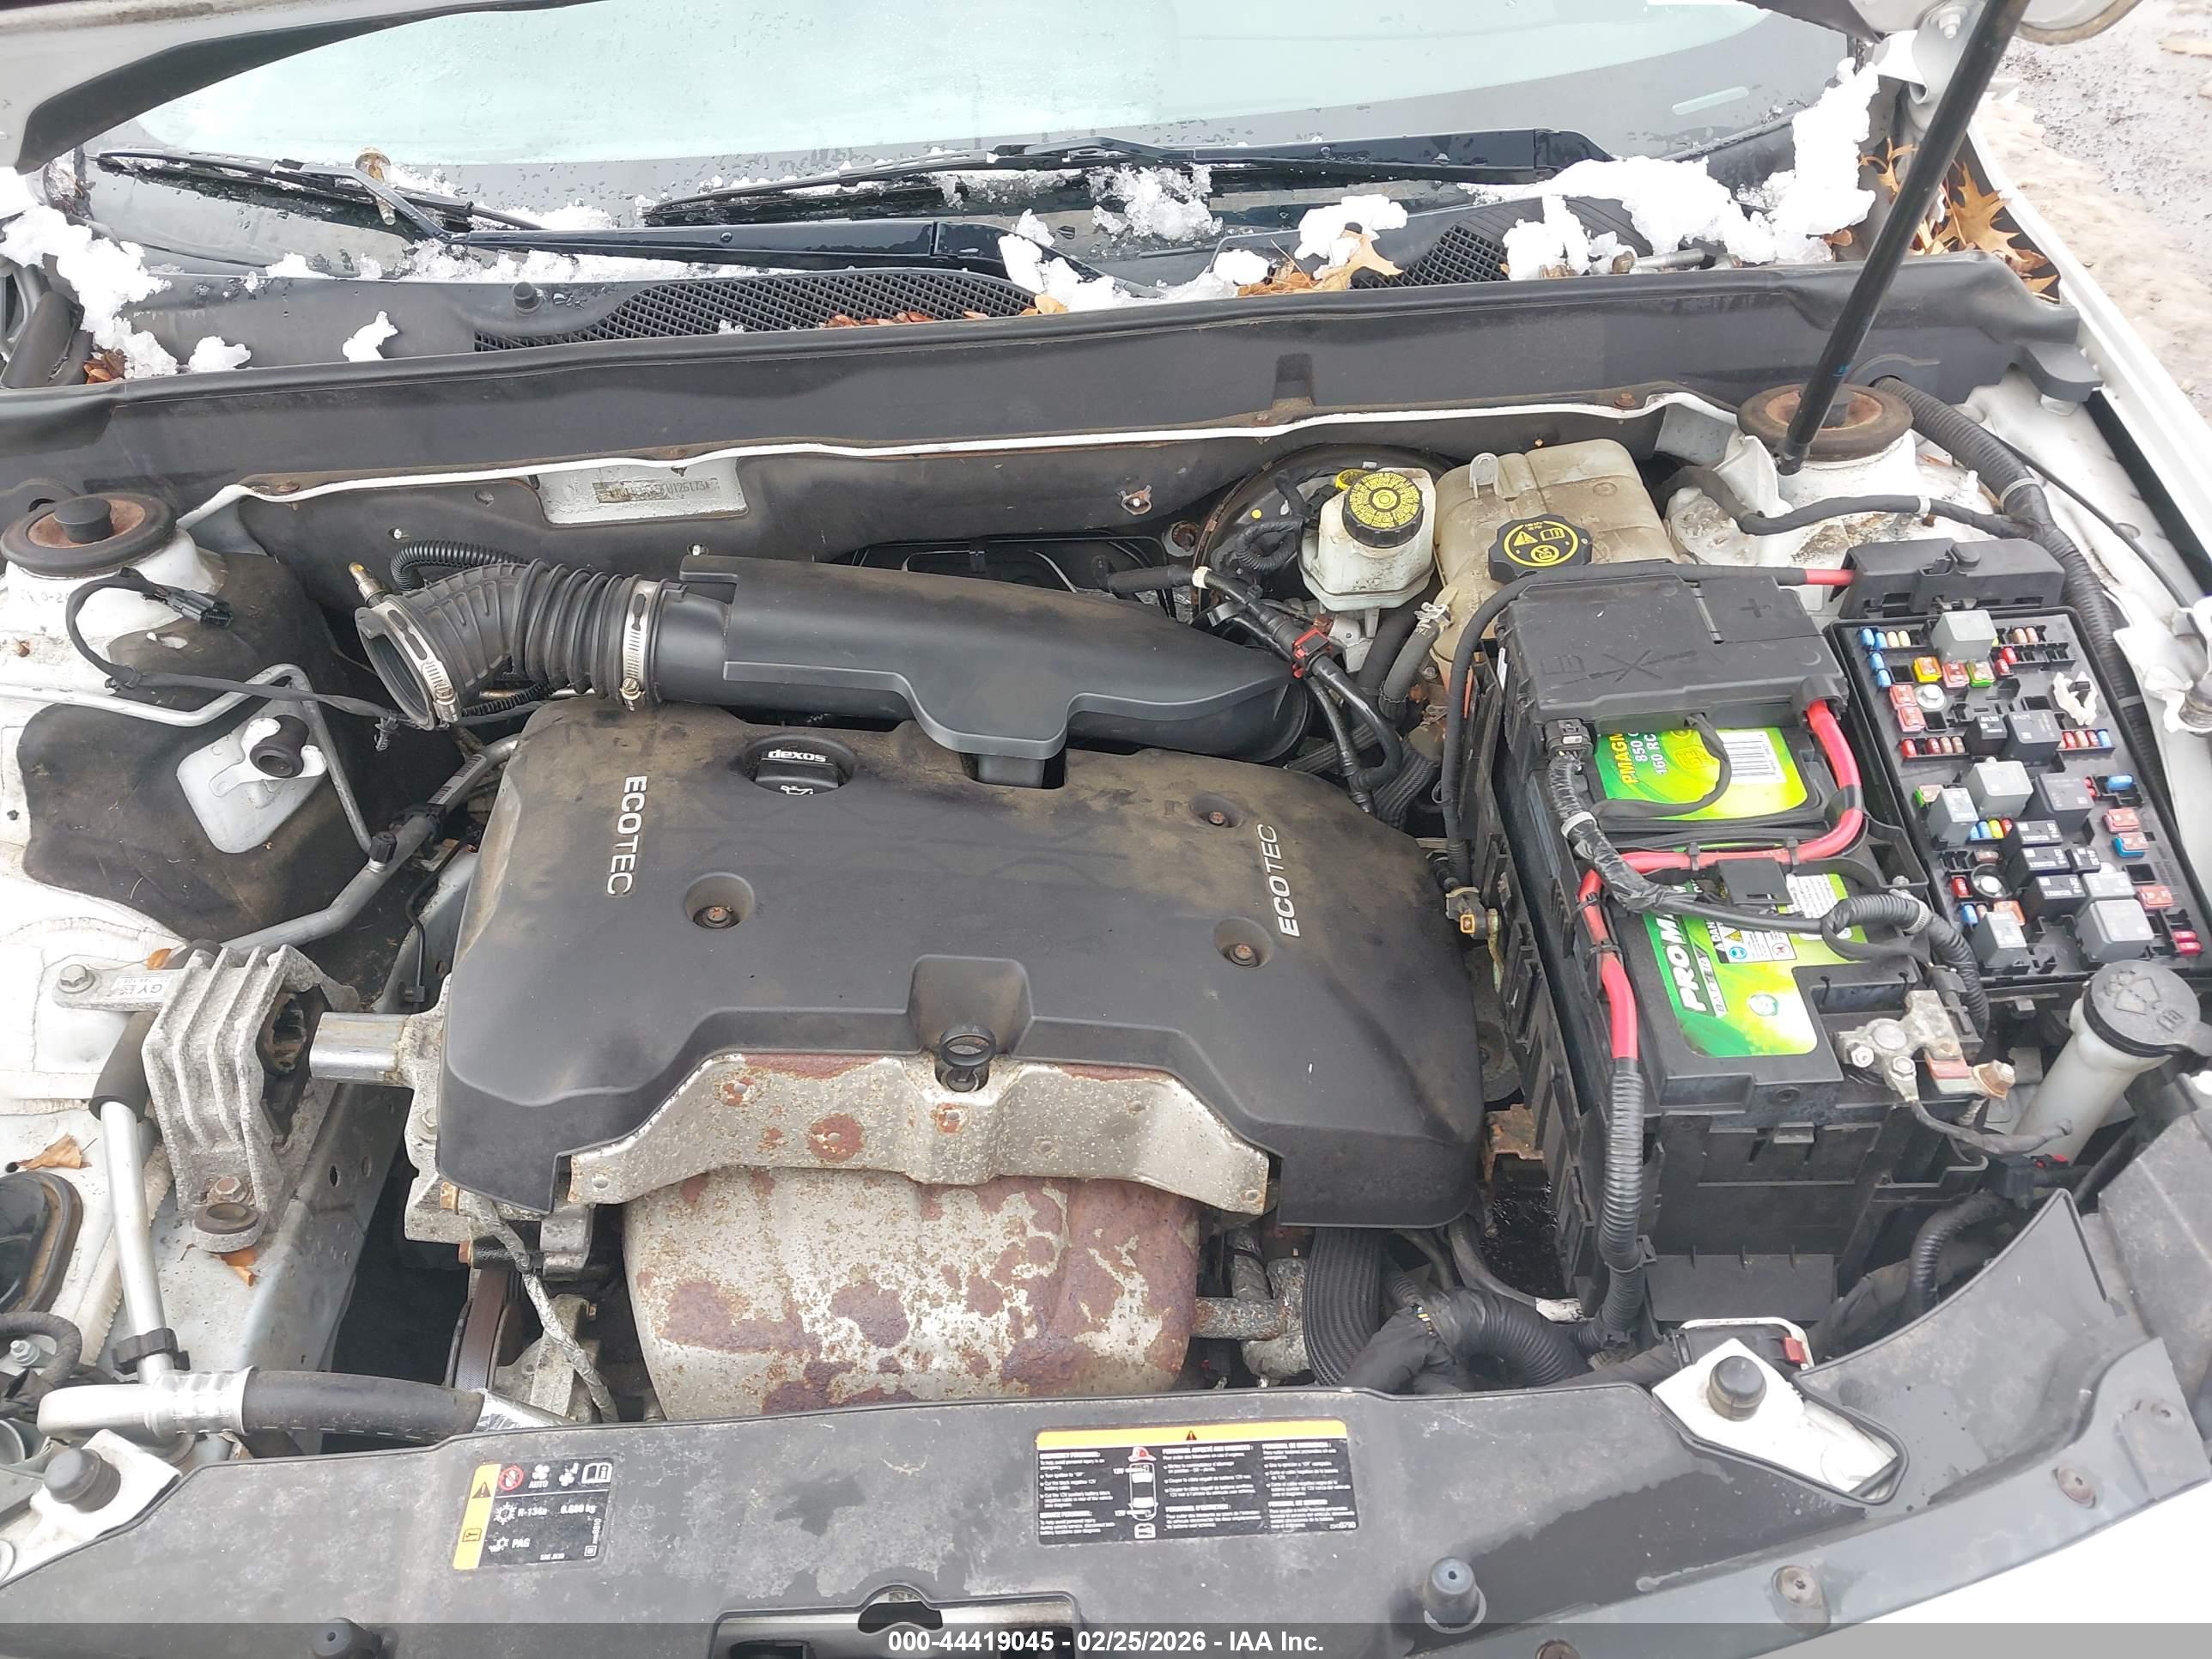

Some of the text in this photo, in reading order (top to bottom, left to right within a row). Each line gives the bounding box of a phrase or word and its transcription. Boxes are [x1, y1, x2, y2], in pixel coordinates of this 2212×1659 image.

[768, 749, 827, 763] dexos
[1632, 740, 1649, 763] 850
[1650, 753, 1668, 776] 160
[606, 775, 648, 896] ECOTEC
[1256, 823, 1300, 937] ECOTEC
[1697, 950, 1725, 1012] BATTERY
[528, 1480, 549, 1489] AUTO
[517, 1507, 548, 1517] R-134a
[511, 1538, 531, 1549] PAG
